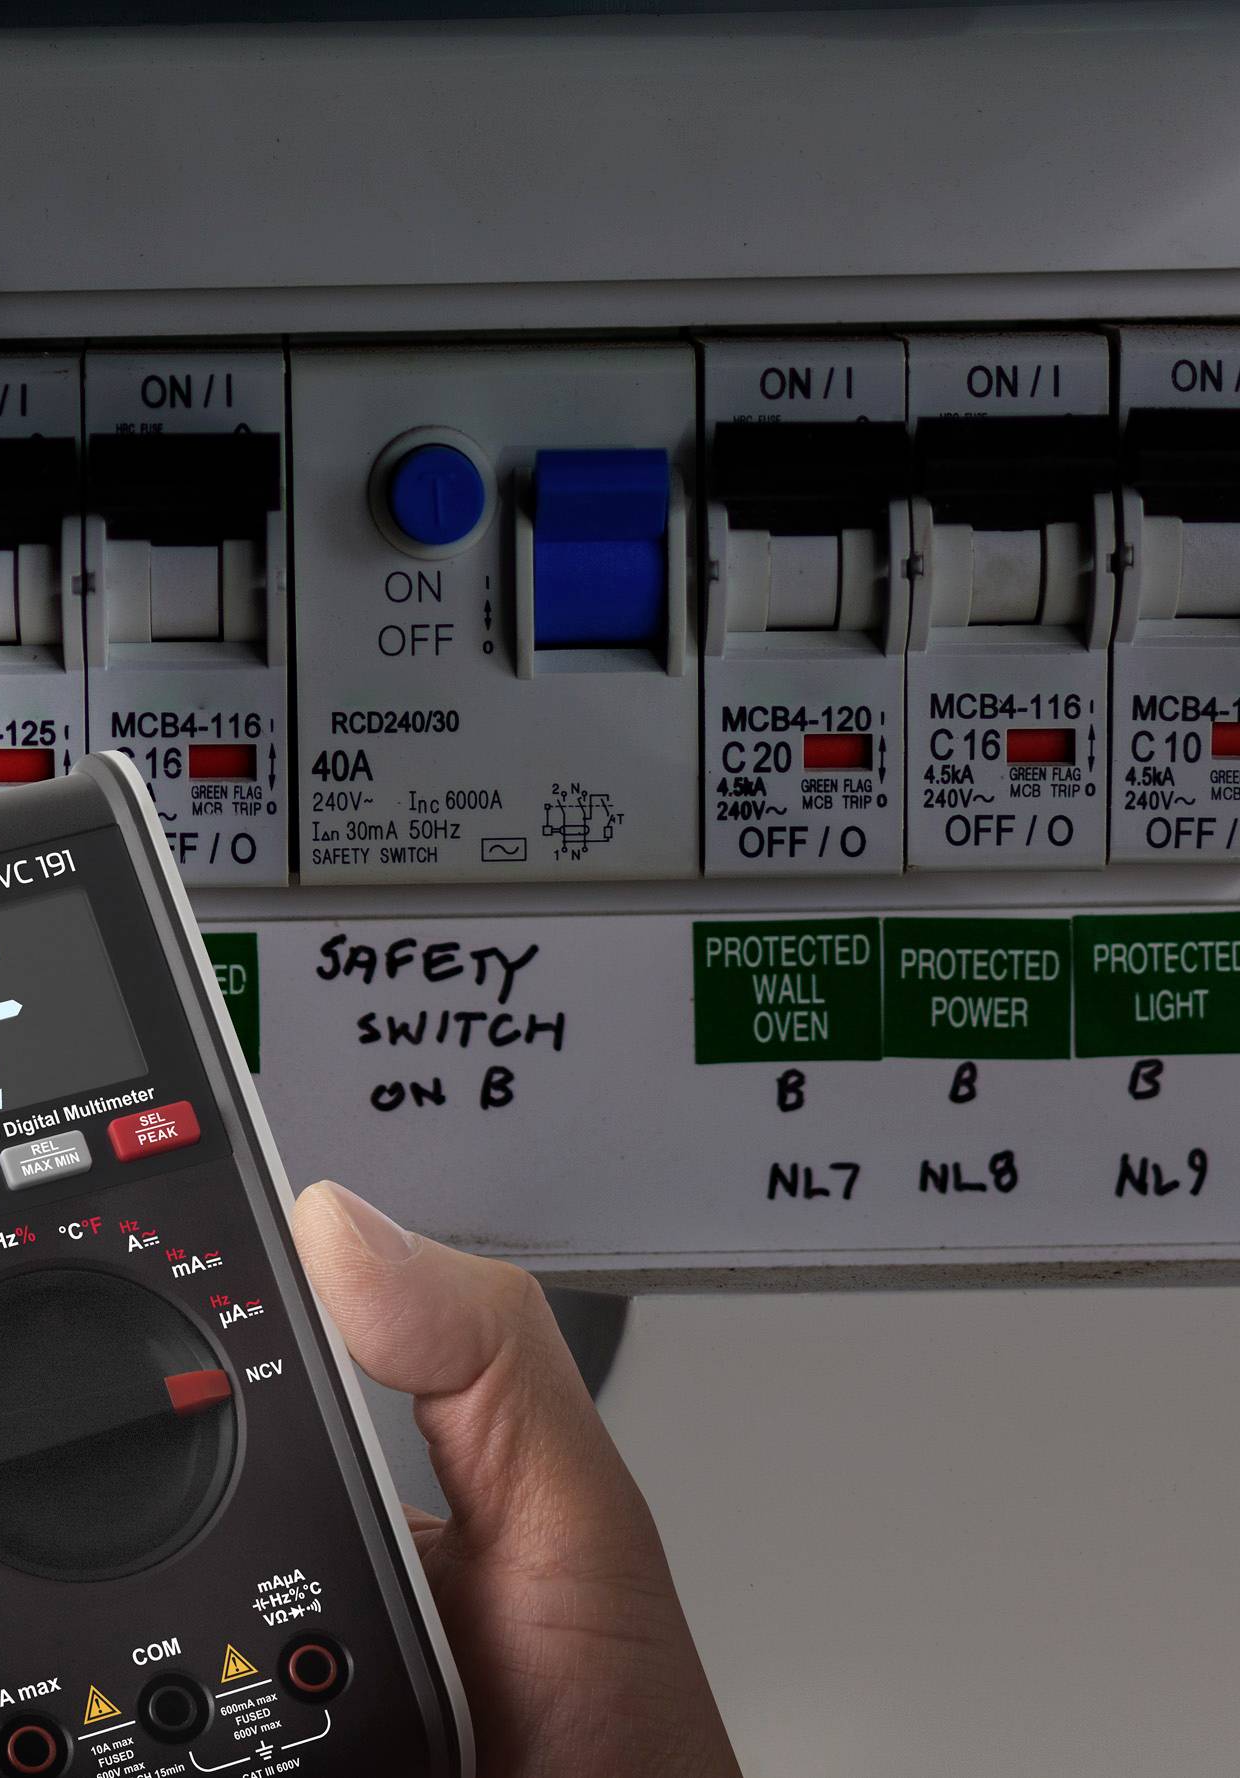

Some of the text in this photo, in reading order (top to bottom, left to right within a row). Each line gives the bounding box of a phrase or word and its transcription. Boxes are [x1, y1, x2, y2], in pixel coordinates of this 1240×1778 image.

[760, 368, 811, 399] ON
[967, 366, 1018, 397] ON
[1172, 360, 1222, 392] ON
[141, 375, 191, 408] ON
[385, 571, 441, 602] ON
[378, 624, 453, 656] OFF
[722, 706, 872, 731] MCB4-120
[930, 694, 1081, 719] MCB4-116
[112, 712, 261, 738] MCB4-116
[332, 711, 459, 734] RCD240/30
[722, 742, 791, 772] C 20
[930, 730, 1000, 760] C 16
[1131, 731, 1201, 763] C 10
[312, 750, 373, 781] 40A
[924, 765, 974, 784] 4.5kA
[1009, 767, 1081, 781] GREEN FLAG
[1125, 767, 1174, 786] 4.5kA
[192, 786, 262, 799] GREEN FLAG
[552, 784, 579, 794] 2 N
[717, 778, 766, 796] 4.5kA
[801, 779, 872, 793] GREEN FLAG
[1010, 783, 1080, 798] MCB TRIP
[232, 802, 261, 815] TRIP
[445, 790, 502, 809] 6000A
[802, 794, 872, 809] MCB TRIP
[346, 821, 460, 839] 30mA 50Hz
[739, 827, 808, 857] OFF
[945, 816, 1015, 846] OFF
[1146, 817, 1216, 848] OFF
[35, 849, 76, 879] 191
[313, 847, 438, 864] SAFETY SWITCH
[706, 934, 870, 968] PROTECTED
[317, 934, 539, 1004] SAFETY
[901, 949, 1059, 981] PROTECTED
[753, 975, 824, 1004] WALL
[931, 997, 1027, 1028] POWER
[1134, 990, 1209, 1022] LIGHT
[358, 1011, 564, 1050] SWITCH
[753, 1011, 828, 1043] OVEN
[371, 1066, 515, 1111] ON B
[776, 1069, 805, 1112] B
[949, 1062, 977, 1102] B
[1129, 1059, 1164, 1099] B
[3, 1108, 60, 1139] Digital
[63, 1087, 155, 1122] Multimeter
[139, 1112, 166, 1126] SEL
[30, 1139, 59, 1155] REL
[137, 1126, 179, 1145] PEAK
[21, 1151, 80, 1177] MAX MIN
[919, 1150, 1018, 1192] NL8
[1115, 1148, 1208, 1197] NL9
[768, 1162, 860, 1200] NL7
[120, 1219, 140, 1234] Hz
[166, 1247, 187, 1262] Hz
[210, 1294, 231, 1309] Hz
[245, 1359, 284, 1383] NCV
[132, 1638, 181, 1667] COM
[16, 1675, 61, 1701] max
[220, 1692, 278, 1717] 600mA max
[235, 1708, 271, 1725] FUSED
[234, 1719, 282, 1741] 600V max
[91, 1736, 134, 1756] 10A max
[98, 1750, 134, 1768] FUSED
[124, 1761, 146, 1775] max
[154, 1763, 185, 1778] 15min
[276, 1758, 301, 1773] 600V
